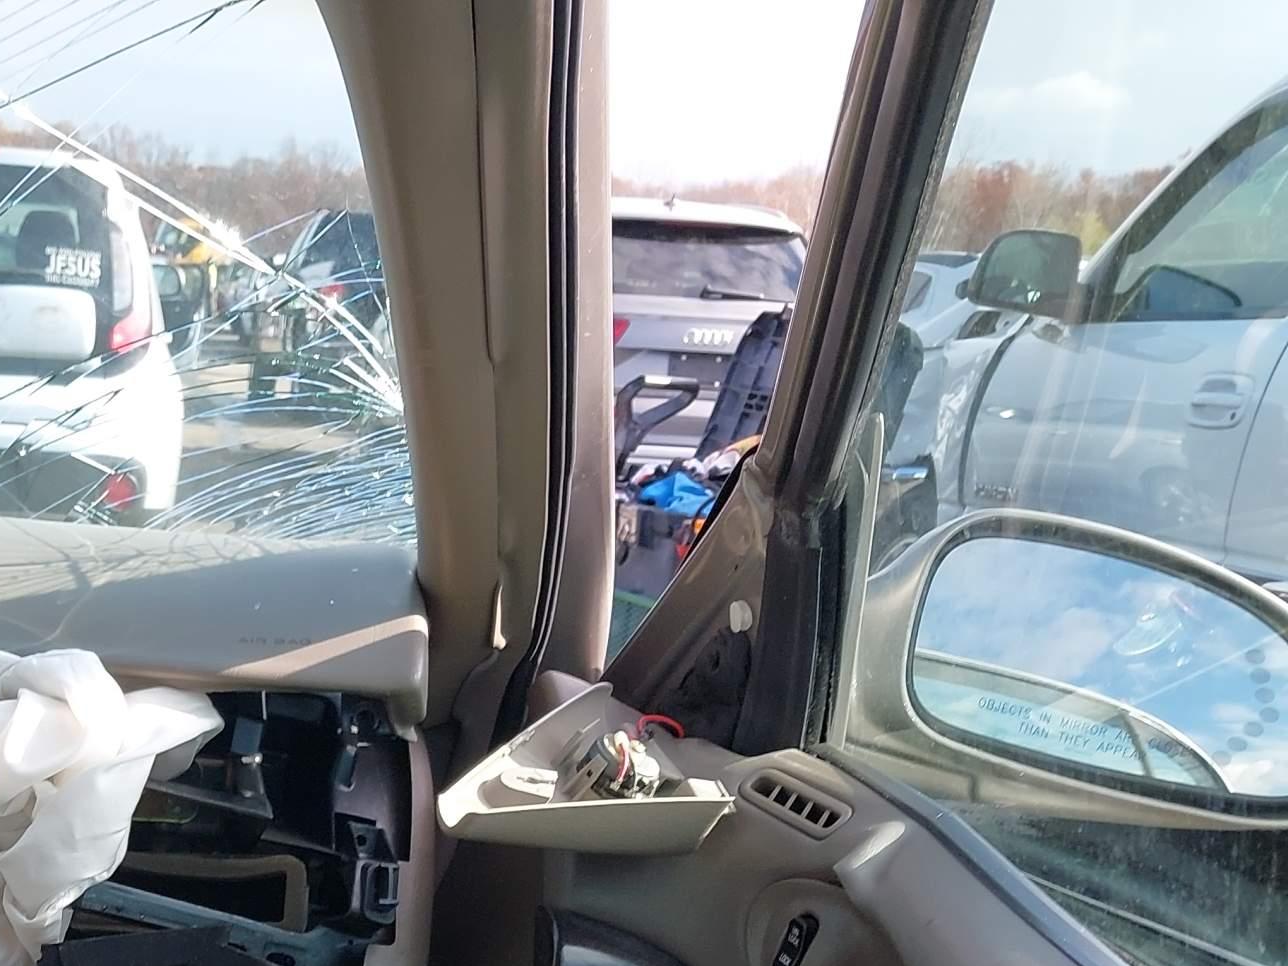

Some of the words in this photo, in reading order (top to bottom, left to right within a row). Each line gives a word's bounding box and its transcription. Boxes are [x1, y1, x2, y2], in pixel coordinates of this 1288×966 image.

[978, 695, 1033, 720] OBJECTS
[1039, 711, 1053, 724] IN
[1061, 717, 1108, 736] MIRROR
[1018, 721, 1050, 738] THAN
[1058, 733, 1091, 750] THEY
